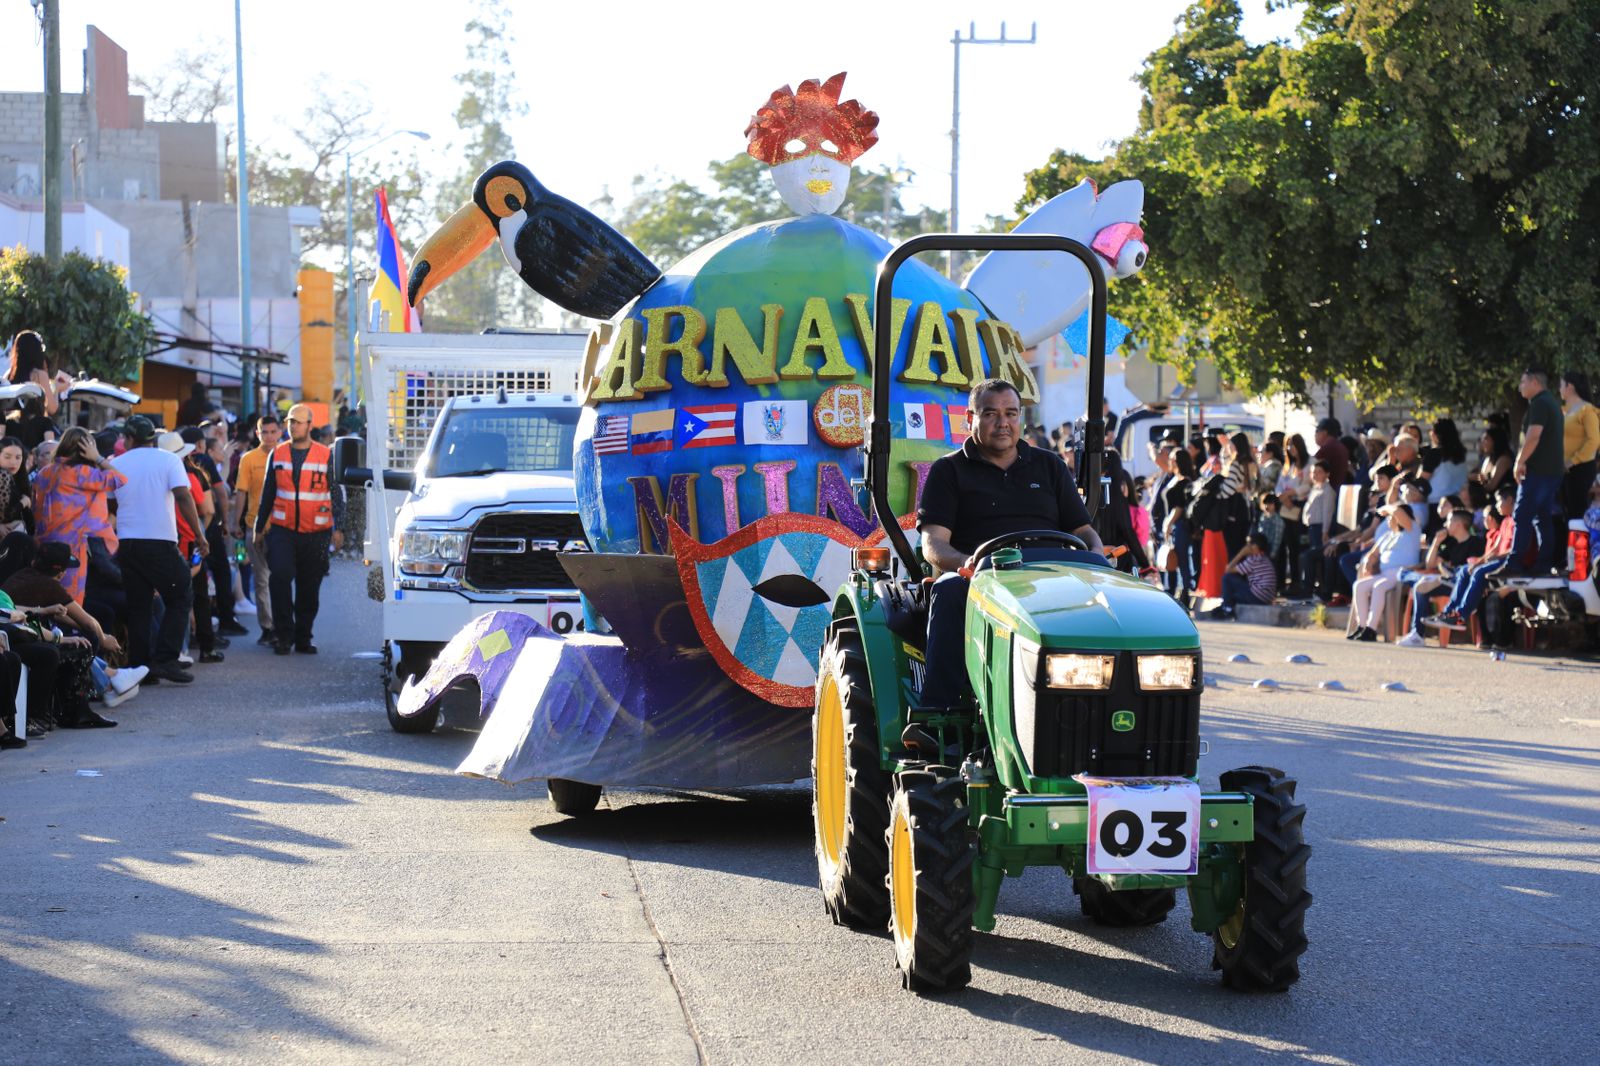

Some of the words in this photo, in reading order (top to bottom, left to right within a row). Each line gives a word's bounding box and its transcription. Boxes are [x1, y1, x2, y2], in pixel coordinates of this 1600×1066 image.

[818, 387, 865, 428] del
[626, 460, 934, 554] MUN
[1100, 809, 1187, 859] 03
